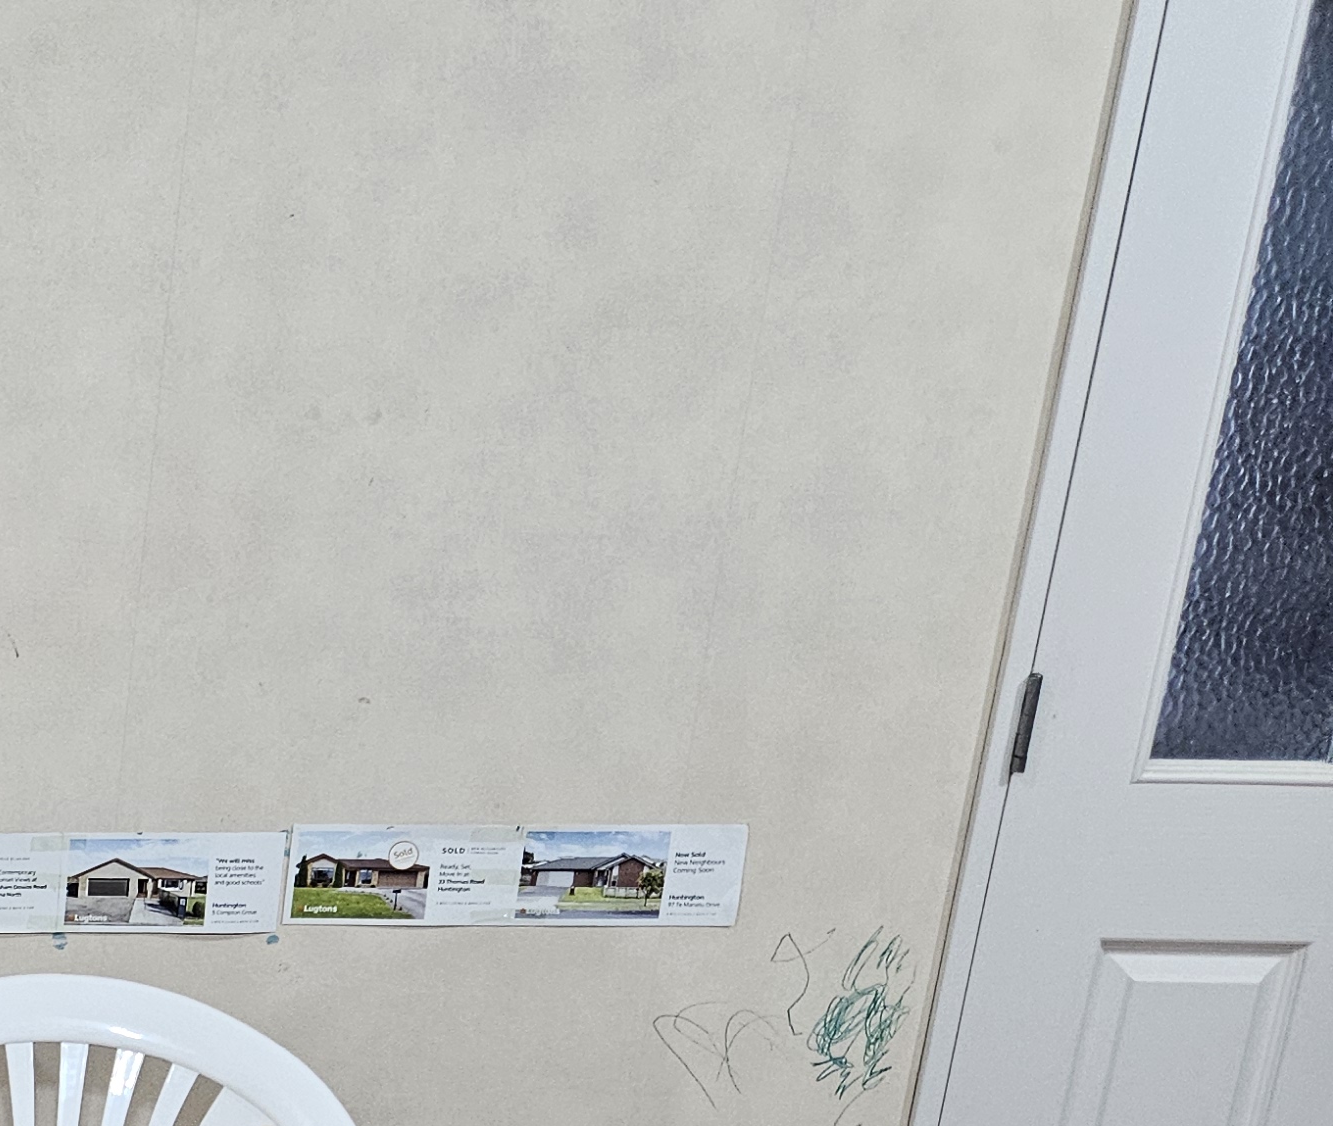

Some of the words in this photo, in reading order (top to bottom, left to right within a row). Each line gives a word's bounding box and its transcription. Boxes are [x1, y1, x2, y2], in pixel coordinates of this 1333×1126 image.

[393, 847, 413, 859] Sold
[441, 847, 466, 855] SOLD
[215, 865, 231, 873] being
[673, 867, 696, 875] Coming
[226, 880, 240, 888] good
[303, 904, 338, 914] Lugtons
[73, 913, 108, 923] Lugtons
